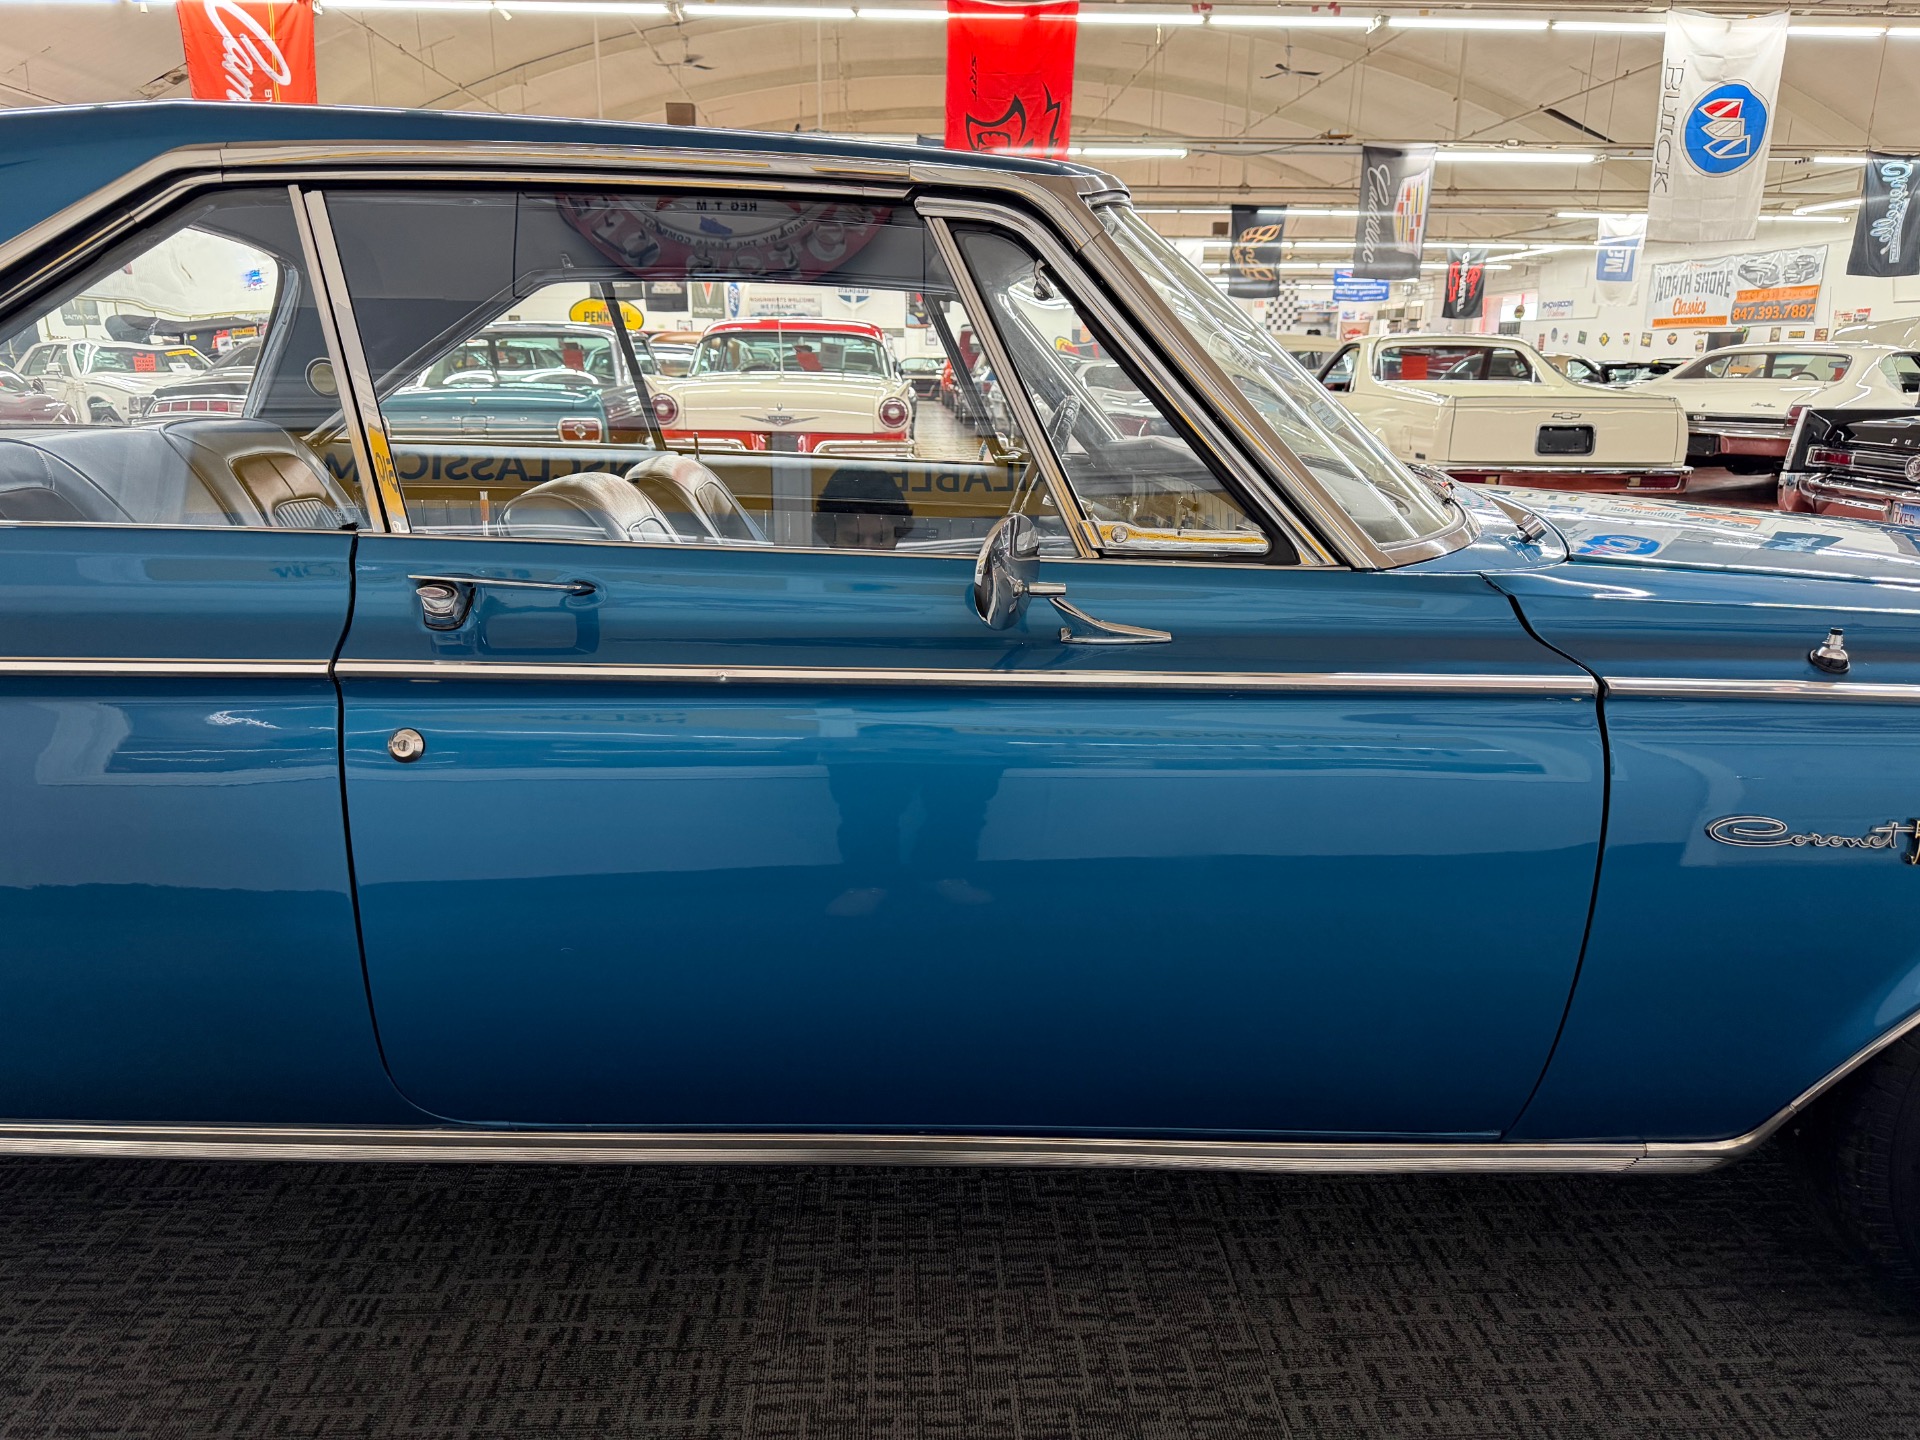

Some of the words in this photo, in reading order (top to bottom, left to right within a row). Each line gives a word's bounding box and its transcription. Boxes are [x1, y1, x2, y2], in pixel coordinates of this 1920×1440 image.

[1652, 57, 1686, 194] BUICK
[1362, 163, 1391, 264] Cadillac
[1654, 273, 1693, 304] NORTH
[1694, 269, 1734, 299] SHORE
[583, 311, 631, 323] PENNIL
[693, 306, 724, 315] PONTIAC
[1672, 296, 1707, 316] Classics
[1732, 303, 1817, 321] 847.393.7887
[1704, 815, 1914, 849] Coronet
